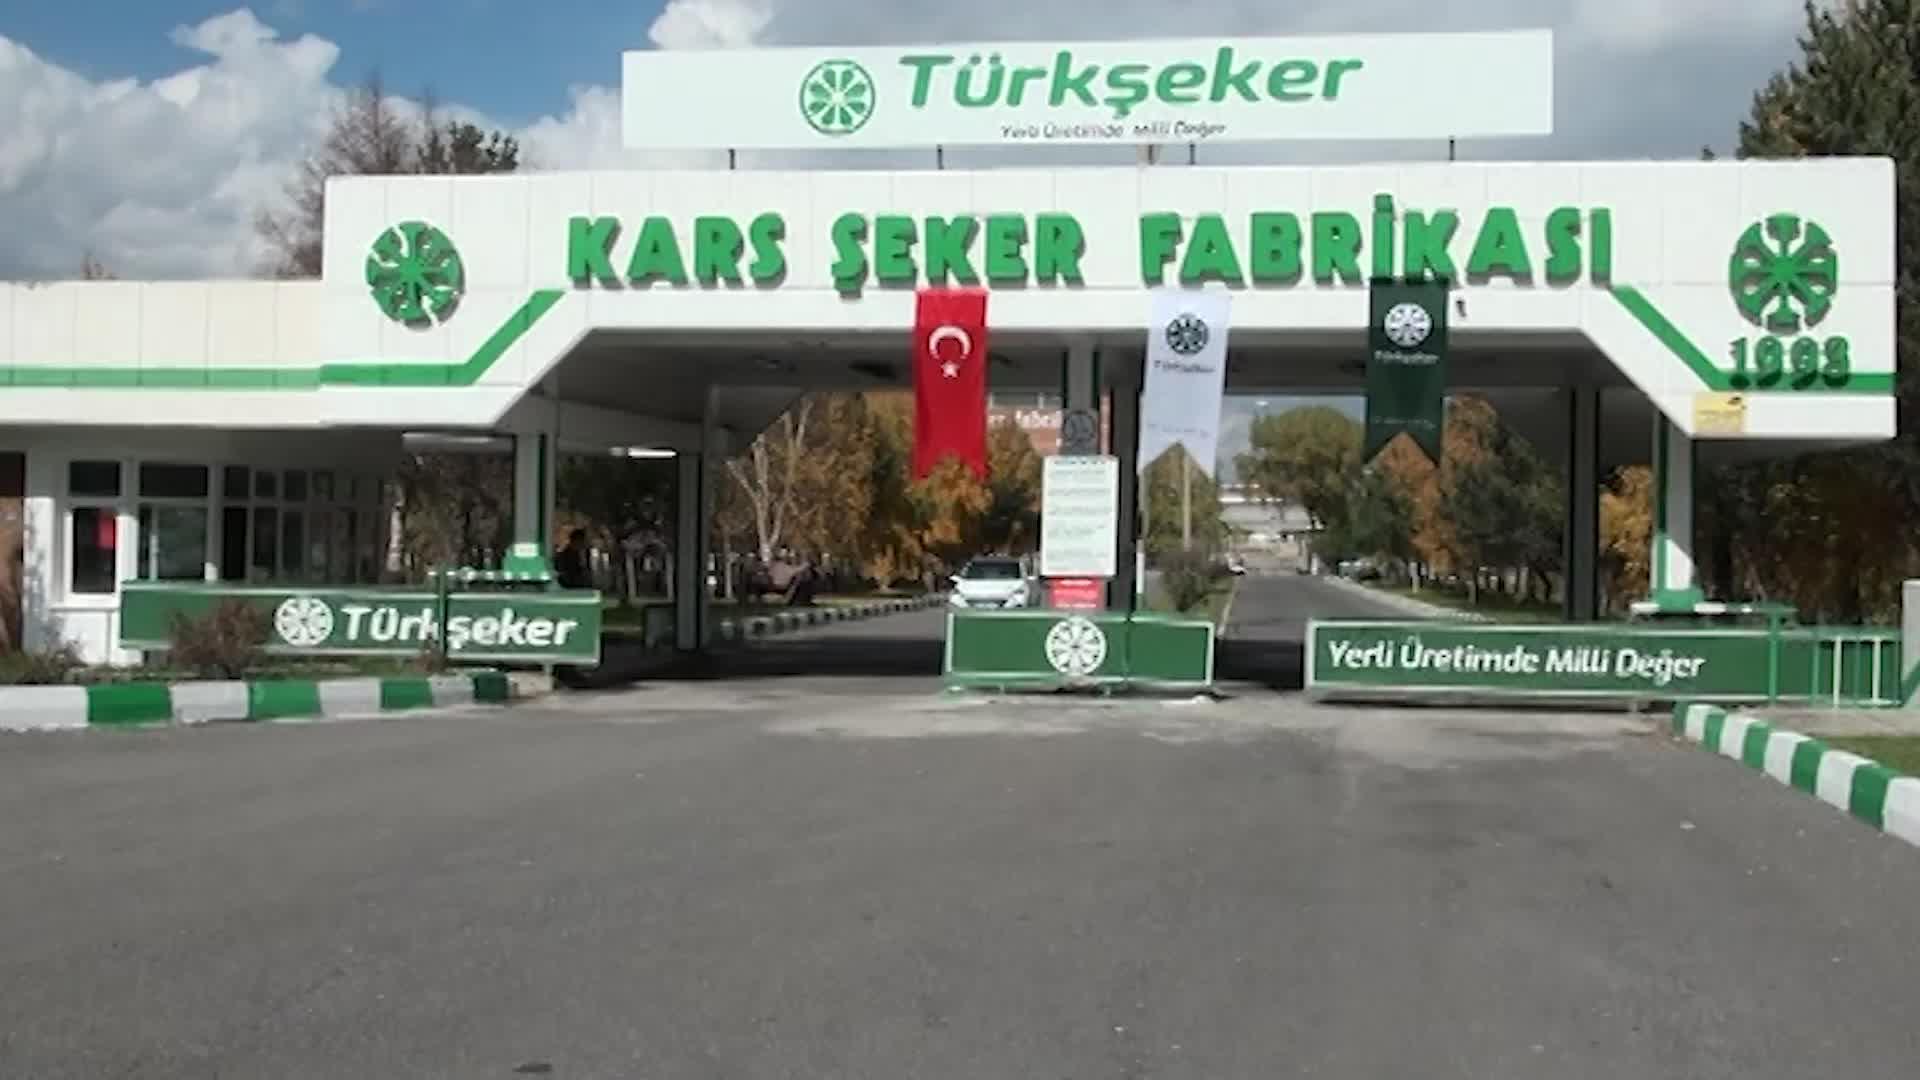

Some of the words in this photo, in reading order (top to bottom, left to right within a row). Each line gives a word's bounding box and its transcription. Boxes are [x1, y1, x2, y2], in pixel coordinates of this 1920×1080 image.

[899, 46, 1363, 119] Türkşeker
[566, 213, 787, 290] KARS
[830, 212, 1086, 300] ŞEKER
[1139, 193, 1614, 289] FABRİKASI
[341, 604, 577, 649] Türkşeker
[1328, 640, 1394, 668] Yerli
[1400, 635, 1540, 674] Üretimde
[1544, 647, 1611, 674] Milli
[1614, 648, 1707, 687] Değer
